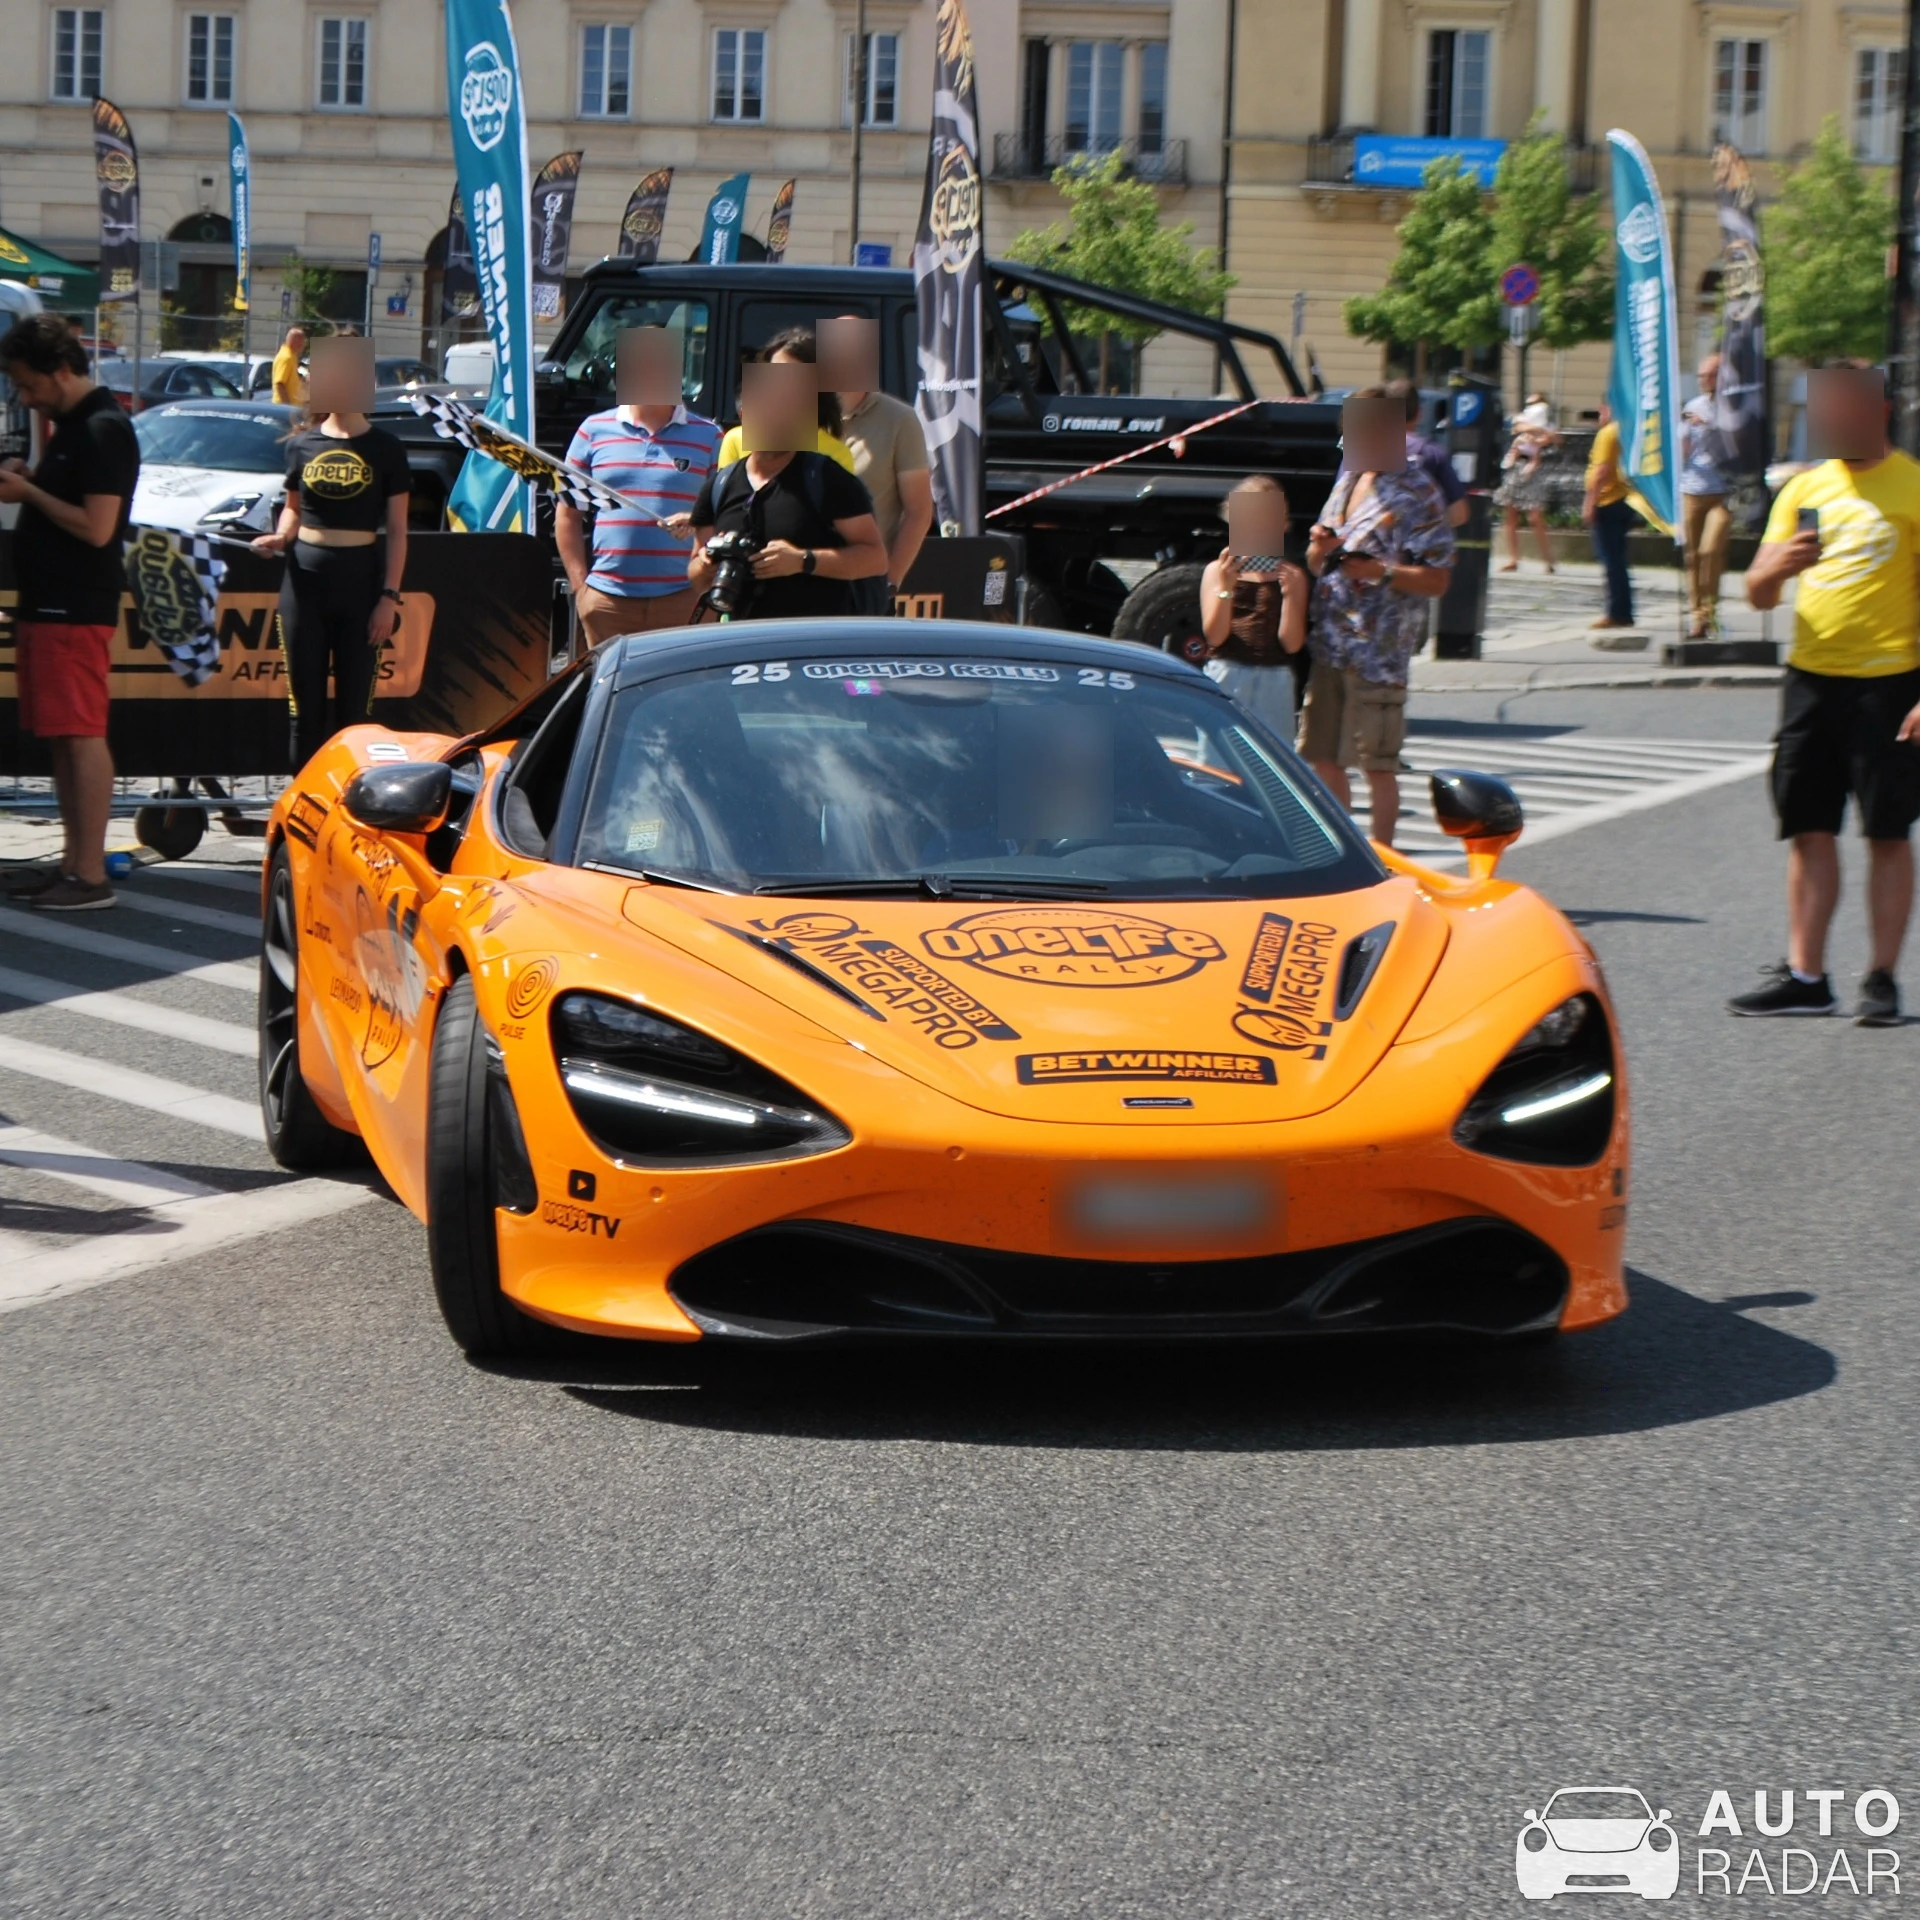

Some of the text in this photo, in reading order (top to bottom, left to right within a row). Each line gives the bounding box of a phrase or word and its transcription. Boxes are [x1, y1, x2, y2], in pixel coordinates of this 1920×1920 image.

[1061, 416, 1165, 433] roman_owl
[731, 662, 791, 686] 25
[1077, 668, 1136, 690] 25
[1245, 921, 1289, 991] SUPPORTED BY
[1017, 963, 1165, 975] RALLY
[1275, 922, 1337, 1018] MEGAPRO
[812, 942, 978, 1050] MEGAPRO
[876, 948, 1001, 1027] SUPPORTED BY
[500, 1022, 526, 1040] PULSE
[1031, 1053, 1260, 1072] BETWINNER
[1171, 1070, 1264, 1081] AFFILIATES
